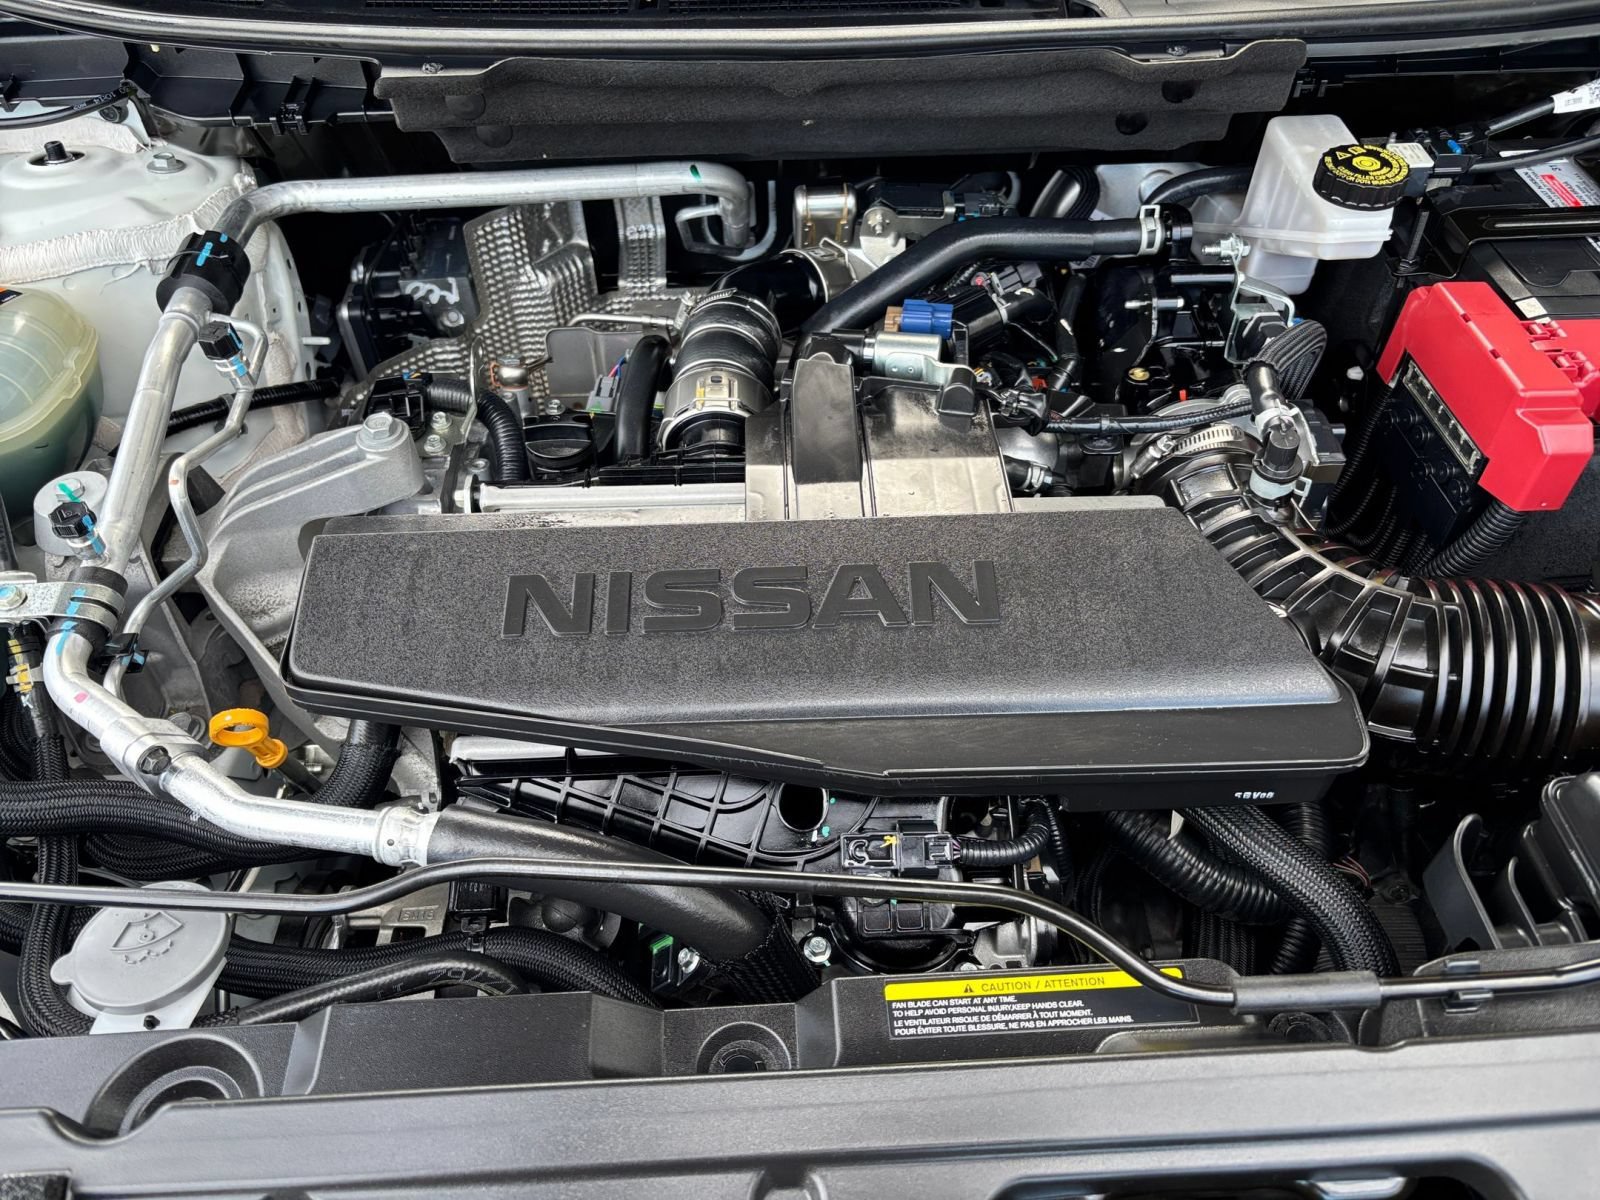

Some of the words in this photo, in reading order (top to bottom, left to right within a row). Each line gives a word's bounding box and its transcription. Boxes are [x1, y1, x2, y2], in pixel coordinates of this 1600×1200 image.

[501, 559, 1000, 638] NISSAN
[981, 980, 1032, 992] CAUTION
[1044, 977, 1105, 989] ATTENTION
[892, 1001, 907, 1009] FAN
[907, 1000, 932, 1009] BLADE
[932, 999, 949, 1007] CAN
[949, 998, 973, 1006] START
[973, 997, 983, 1005] AT
[982, 996, 998, 1004] ANY
[999, 995, 1018, 1003] TIME.
[904, 1009, 924, 1017] HELP
[924, 1007, 947, 1015] AVOID
[947, 1005, 987, 1014] PERSONAL
[1031, 1001, 1058, 1009] HANDS
[1058, 1000, 1084, 1008] CLEAR.
[894, 1027, 917, 1036] POUR
[917, 1024, 942, 1034] ÉVITER
[942, 1025, 967, 1033] TOUTE
[967, 1022, 1008, 1032] BLESSURE,
[1008, 1021, 1020, 1029] NE
[1020, 1020, 1036, 1028] PAS
[1047, 1018, 1093, 1027] APPROCHER
[1093, 1016, 1109, 1024] LES
[1108, 1015, 1134, 1023] MAINS.
[904, 1017, 951, 1027] VENTILATEUR
[951, 1015, 980, 1024] RISQUE
[980, 1014, 991, 1022] DE
[991, 1012, 1032, 1021] DÉMARRER
[1032, 1010, 1040, 1019] À
[1059, 1008, 1093, 1017] MOMENT.
